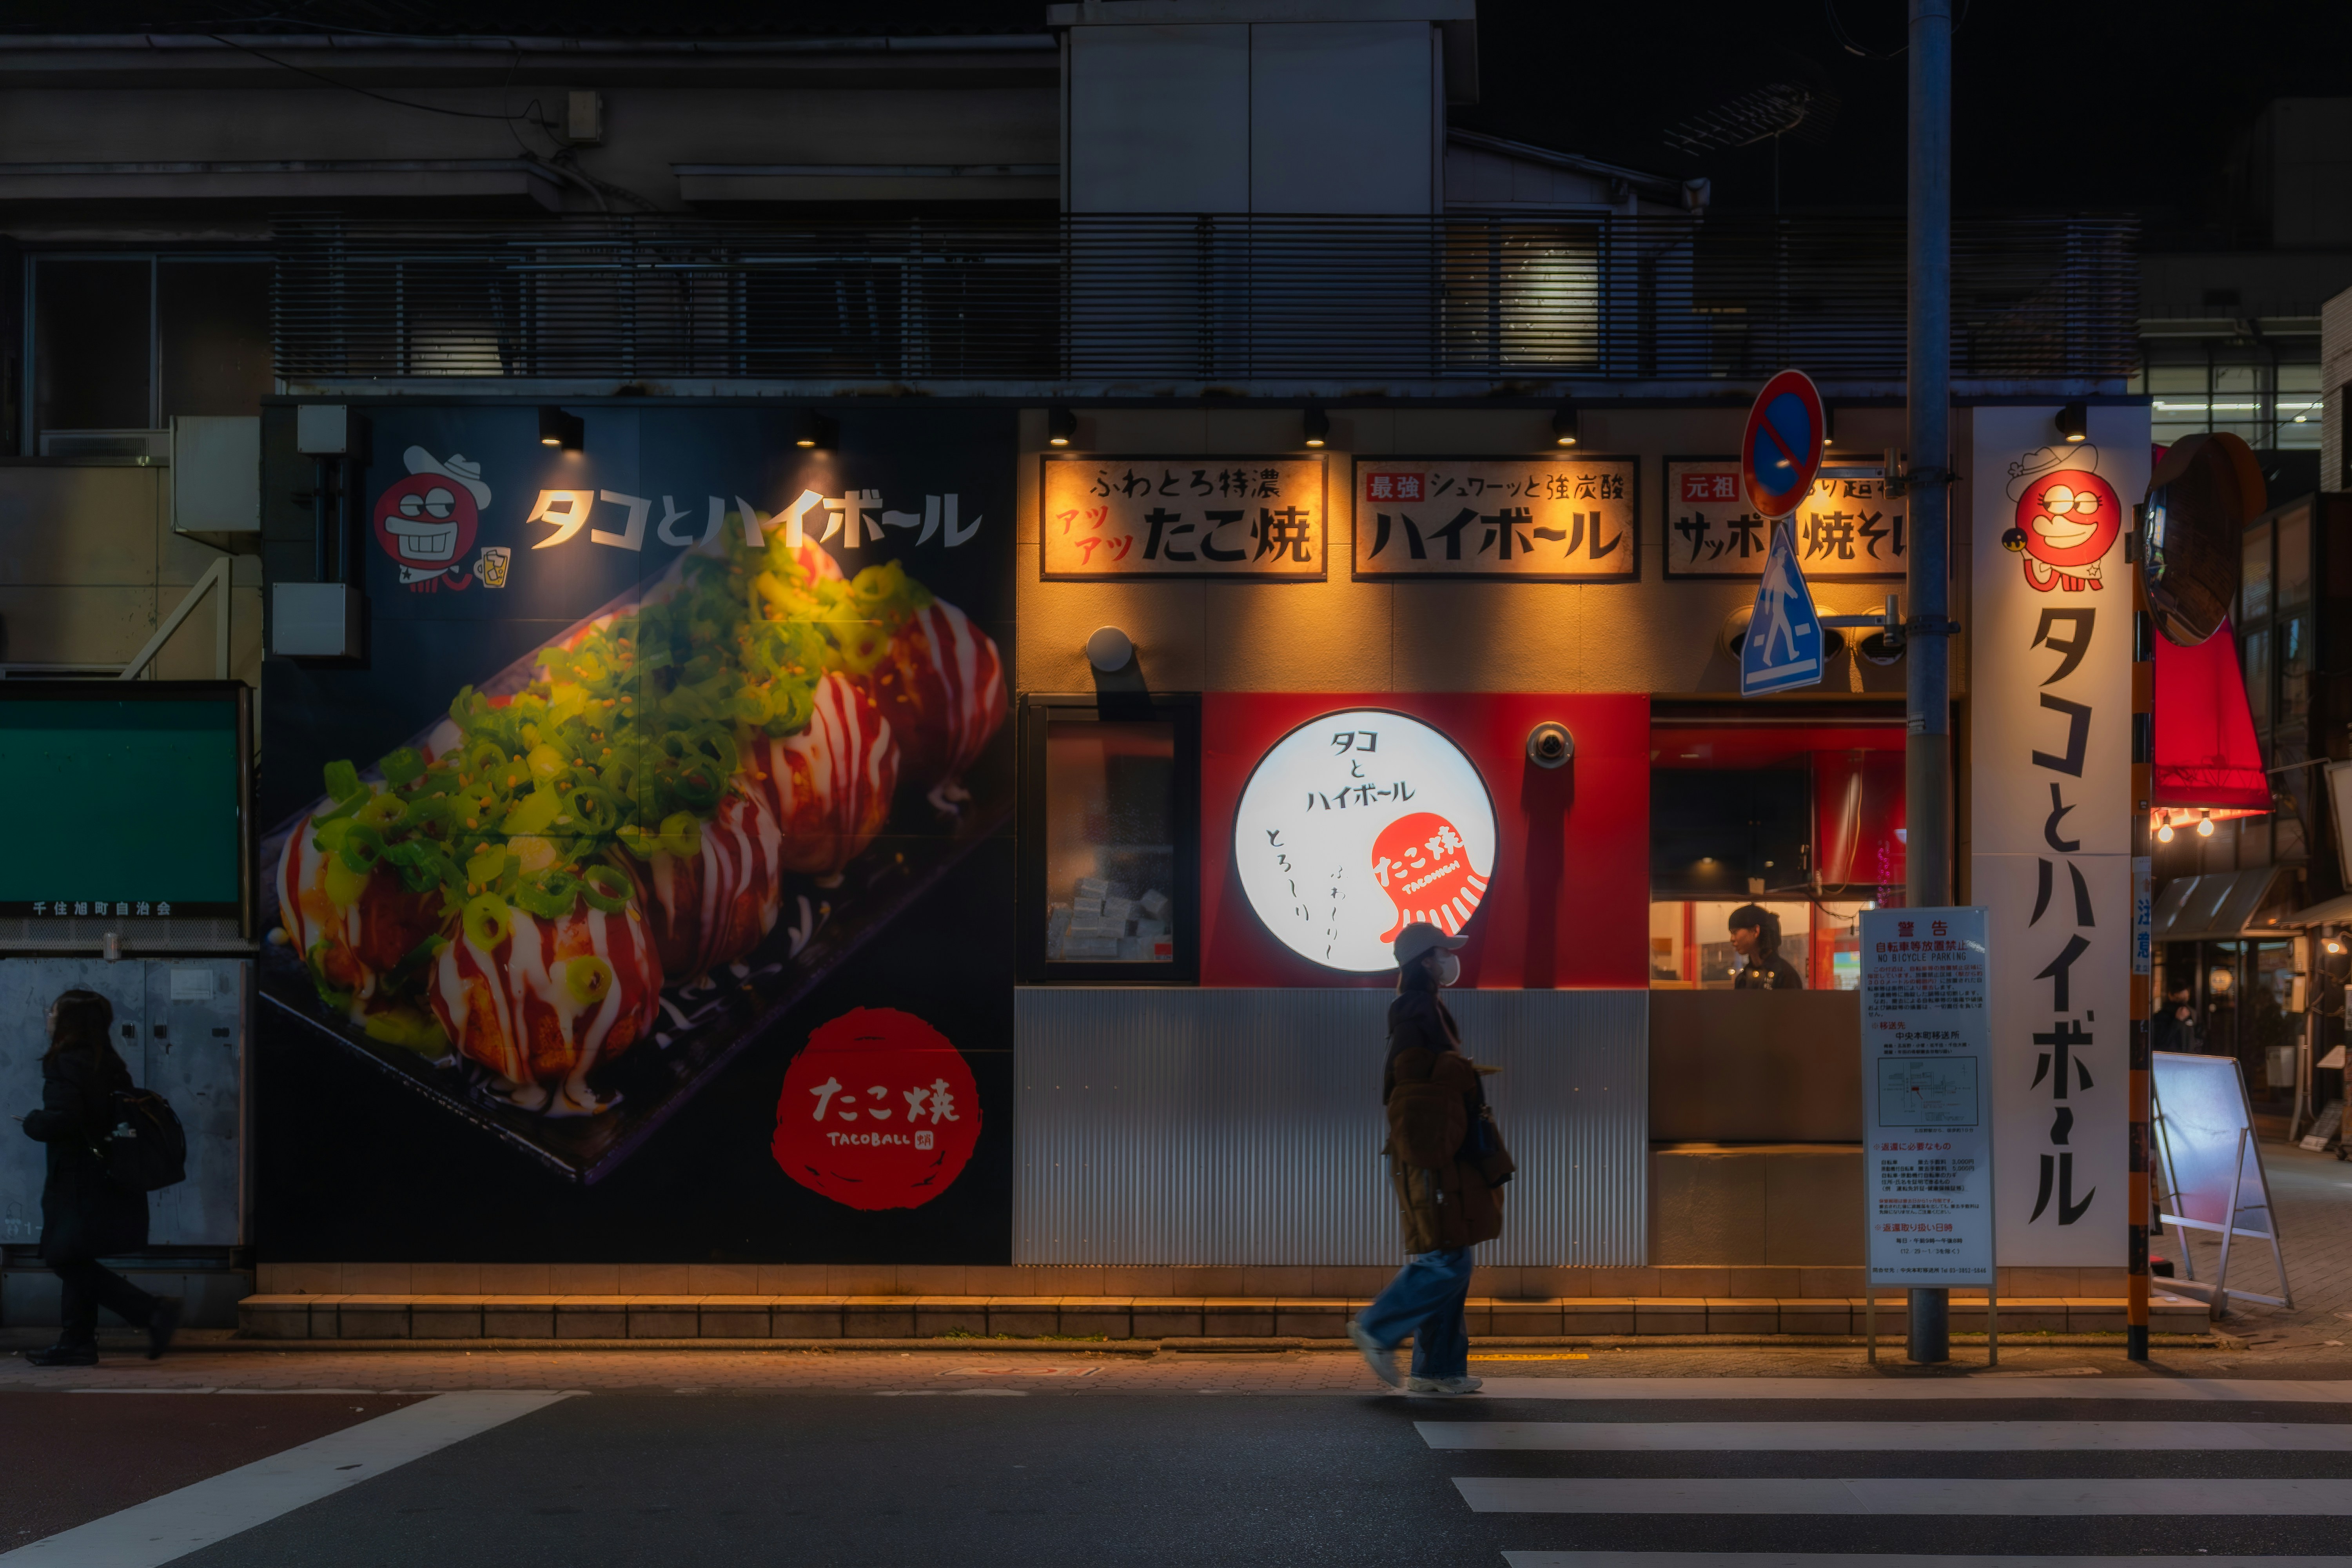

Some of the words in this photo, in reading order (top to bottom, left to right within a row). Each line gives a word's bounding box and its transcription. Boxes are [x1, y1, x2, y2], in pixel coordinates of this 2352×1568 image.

[1090, 468, 1281, 498] ふわとろ特濃
[1370, 476, 1420, 499] 最強
[1430, 473, 1624, 500] シュワーッと強炭酸
[1687, 475, 1736, 498] 元祖
[1056, 505, 1109, 535] アツ
[1142, 505, 1311, 563] たこ焼
[1074, 534, 1134, 566] アツ
[1331, 730, 1378, 756] タコ
[1350, 759, 1365, 778] と
[1373, 825, 1465, 887] たこ焼
[1401, 860, 1461, 895] TACOHIGH
[33, 901, 171, 916] 千住旭町自治会
[1898, 920, 1948, 937] 警告
[2138, 898, 2150, 958] 注意
[1876, 940, 1968, 953] 自転車等放置禁止
[1878, 953, 1888, 963] NO
[1892, 953, 1927, 962] BICYCLE
[1931, 952, 1967, 962] PARKING
[1895, 1031, 1960, 1040] 中央本町移送所
[809, 1076, 960, 1125] たこ焼
[826, 1131, 911, 1147] TACOBALL
